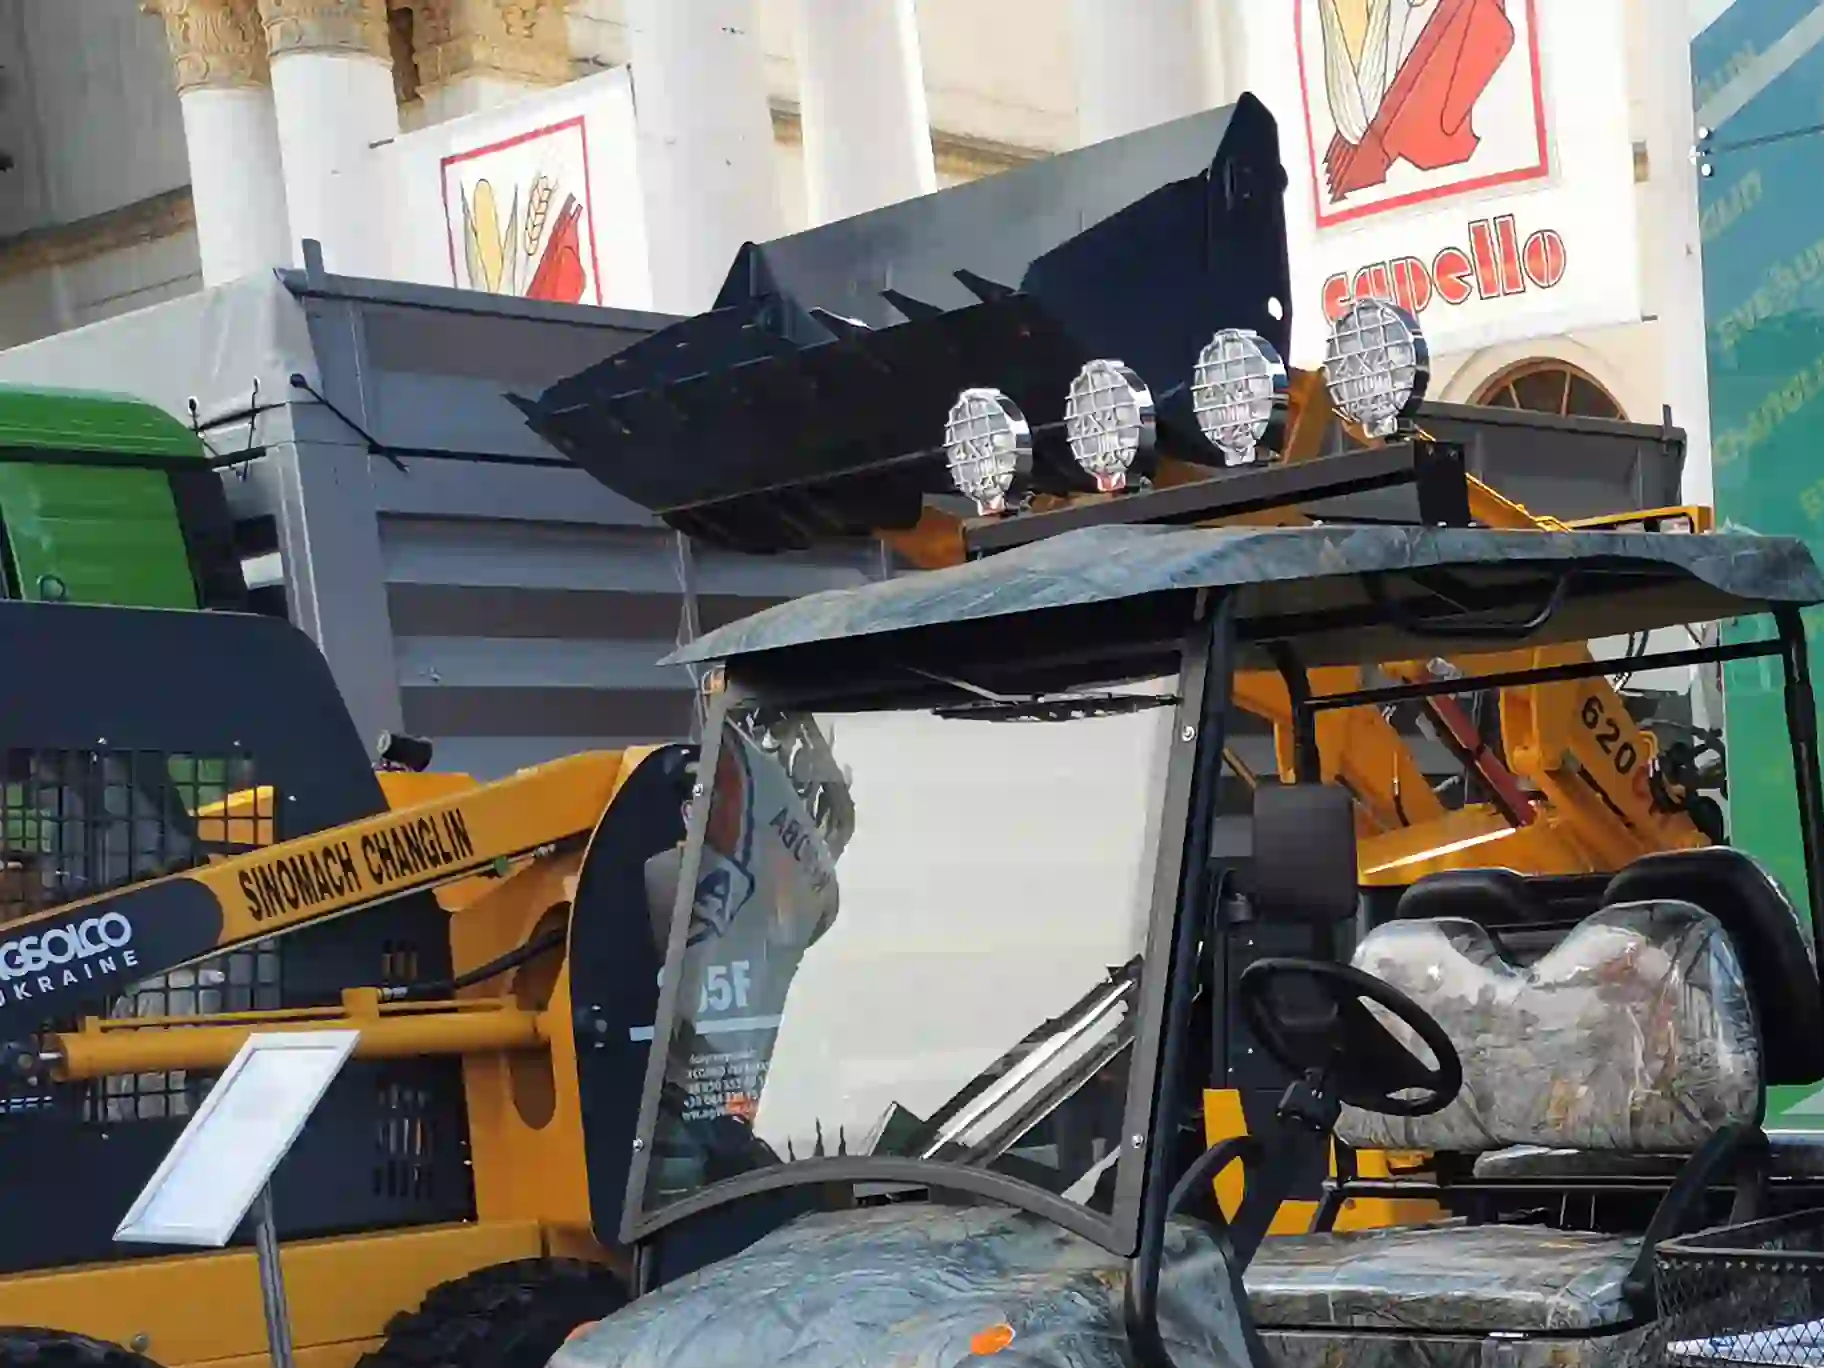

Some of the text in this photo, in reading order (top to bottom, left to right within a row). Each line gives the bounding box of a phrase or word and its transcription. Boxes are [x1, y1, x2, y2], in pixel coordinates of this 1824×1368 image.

[1582, 695, 1636, 774] 620
[237, 808, 475, 921] SINOMACH CHANGLIN
